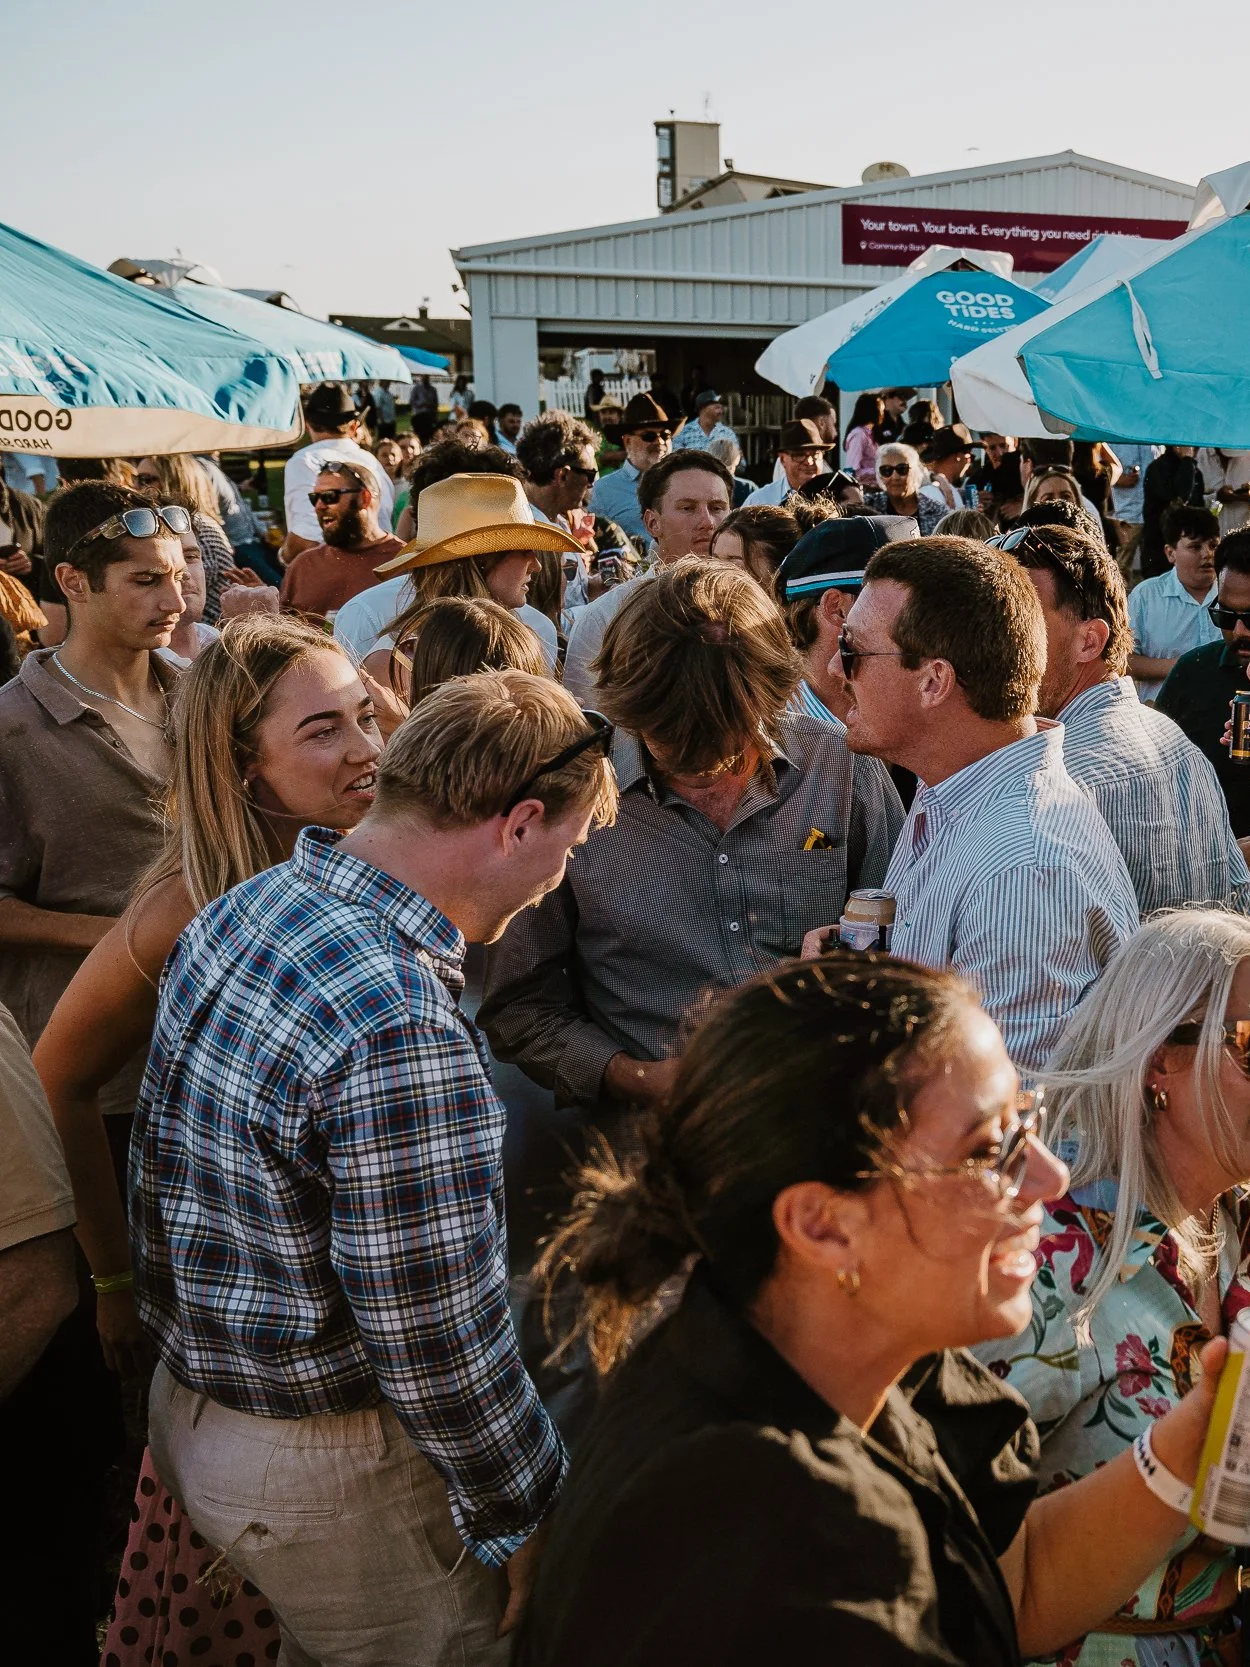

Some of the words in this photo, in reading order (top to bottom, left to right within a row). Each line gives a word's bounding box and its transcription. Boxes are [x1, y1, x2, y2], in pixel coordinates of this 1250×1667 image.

[861, 219, 885, 231] Your
[888, 221, 919, 232] town.
[921, 222, 946, 233] Your
[949, 224, 980, 235] bank.
[981, 225, 1039, 240] Everything
[1041, 229, 1061, 241] you
[1063, 230, 1090, 240] need
[868, 242, 908, 252] Community
[936, 291, 1014, 306] GOOD
[948, 319, 980, 332] HARD
